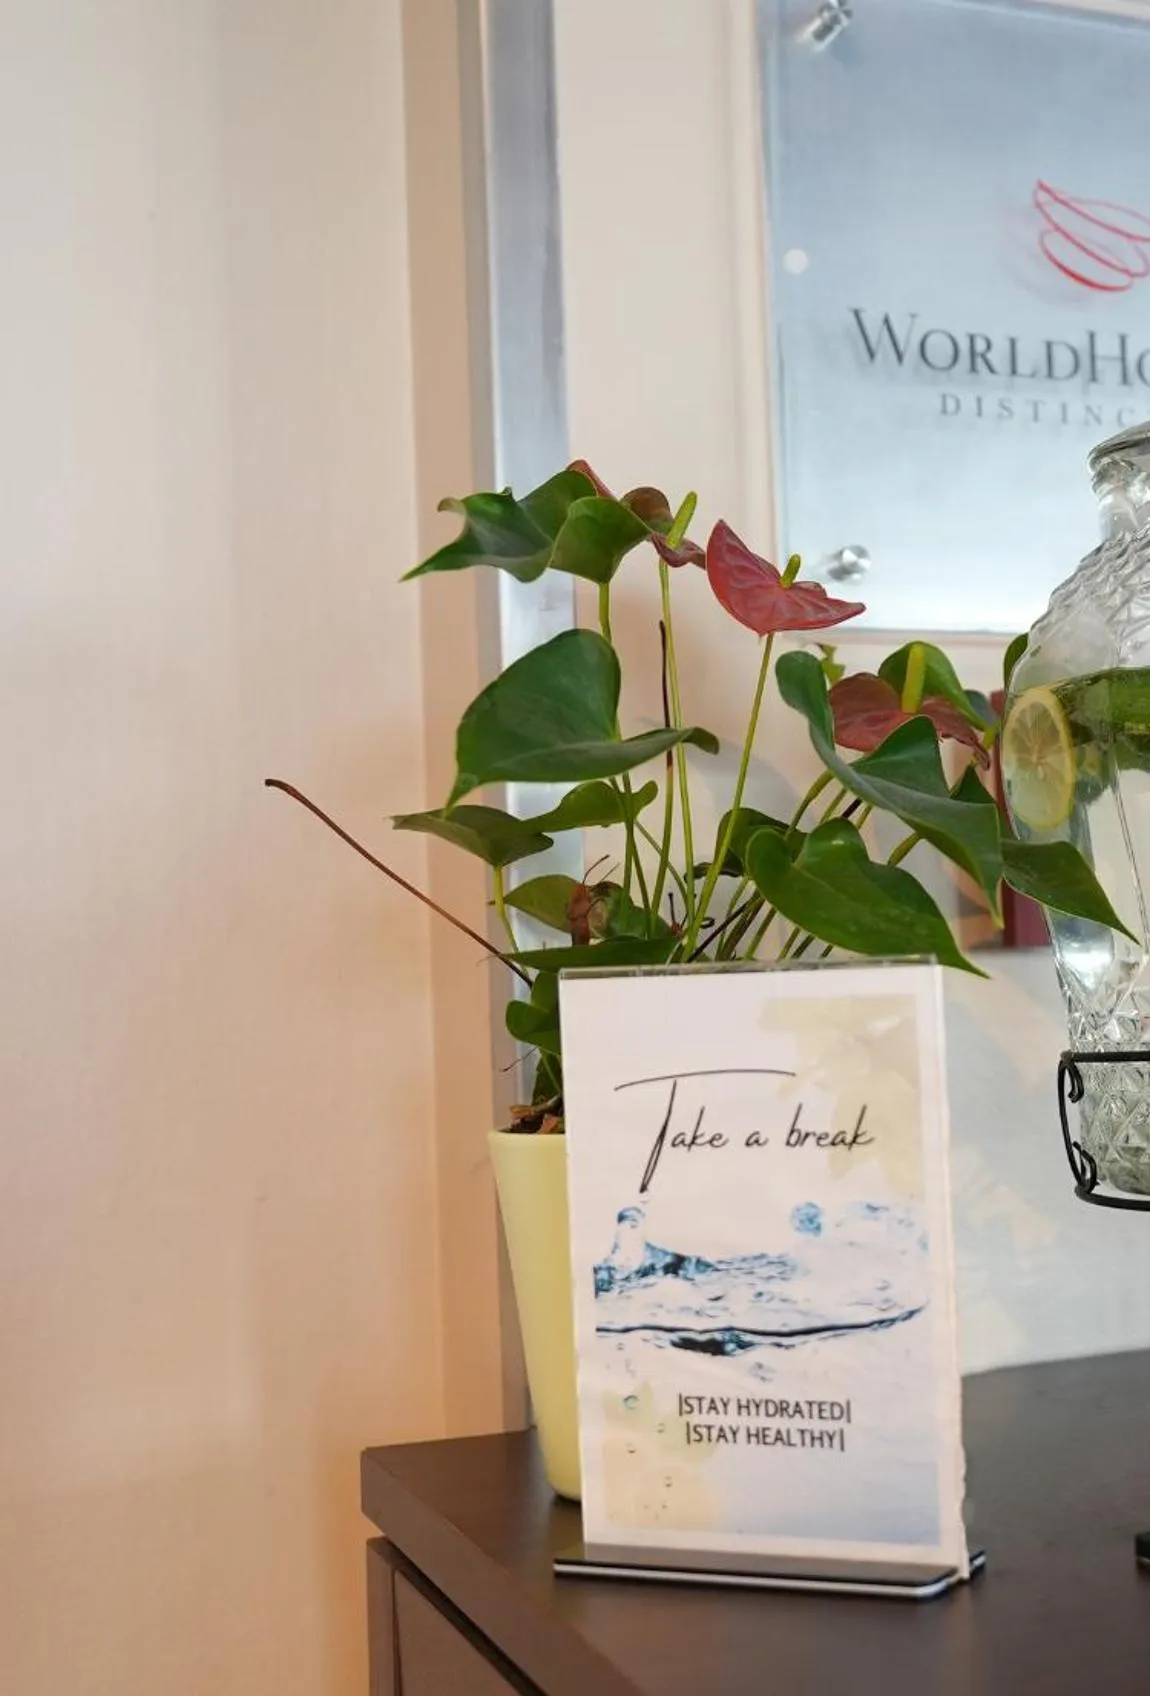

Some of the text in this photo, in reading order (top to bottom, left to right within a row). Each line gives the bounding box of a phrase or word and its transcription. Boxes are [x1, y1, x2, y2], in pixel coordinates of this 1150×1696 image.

[614, 1068, 875, 1194] Take a break
